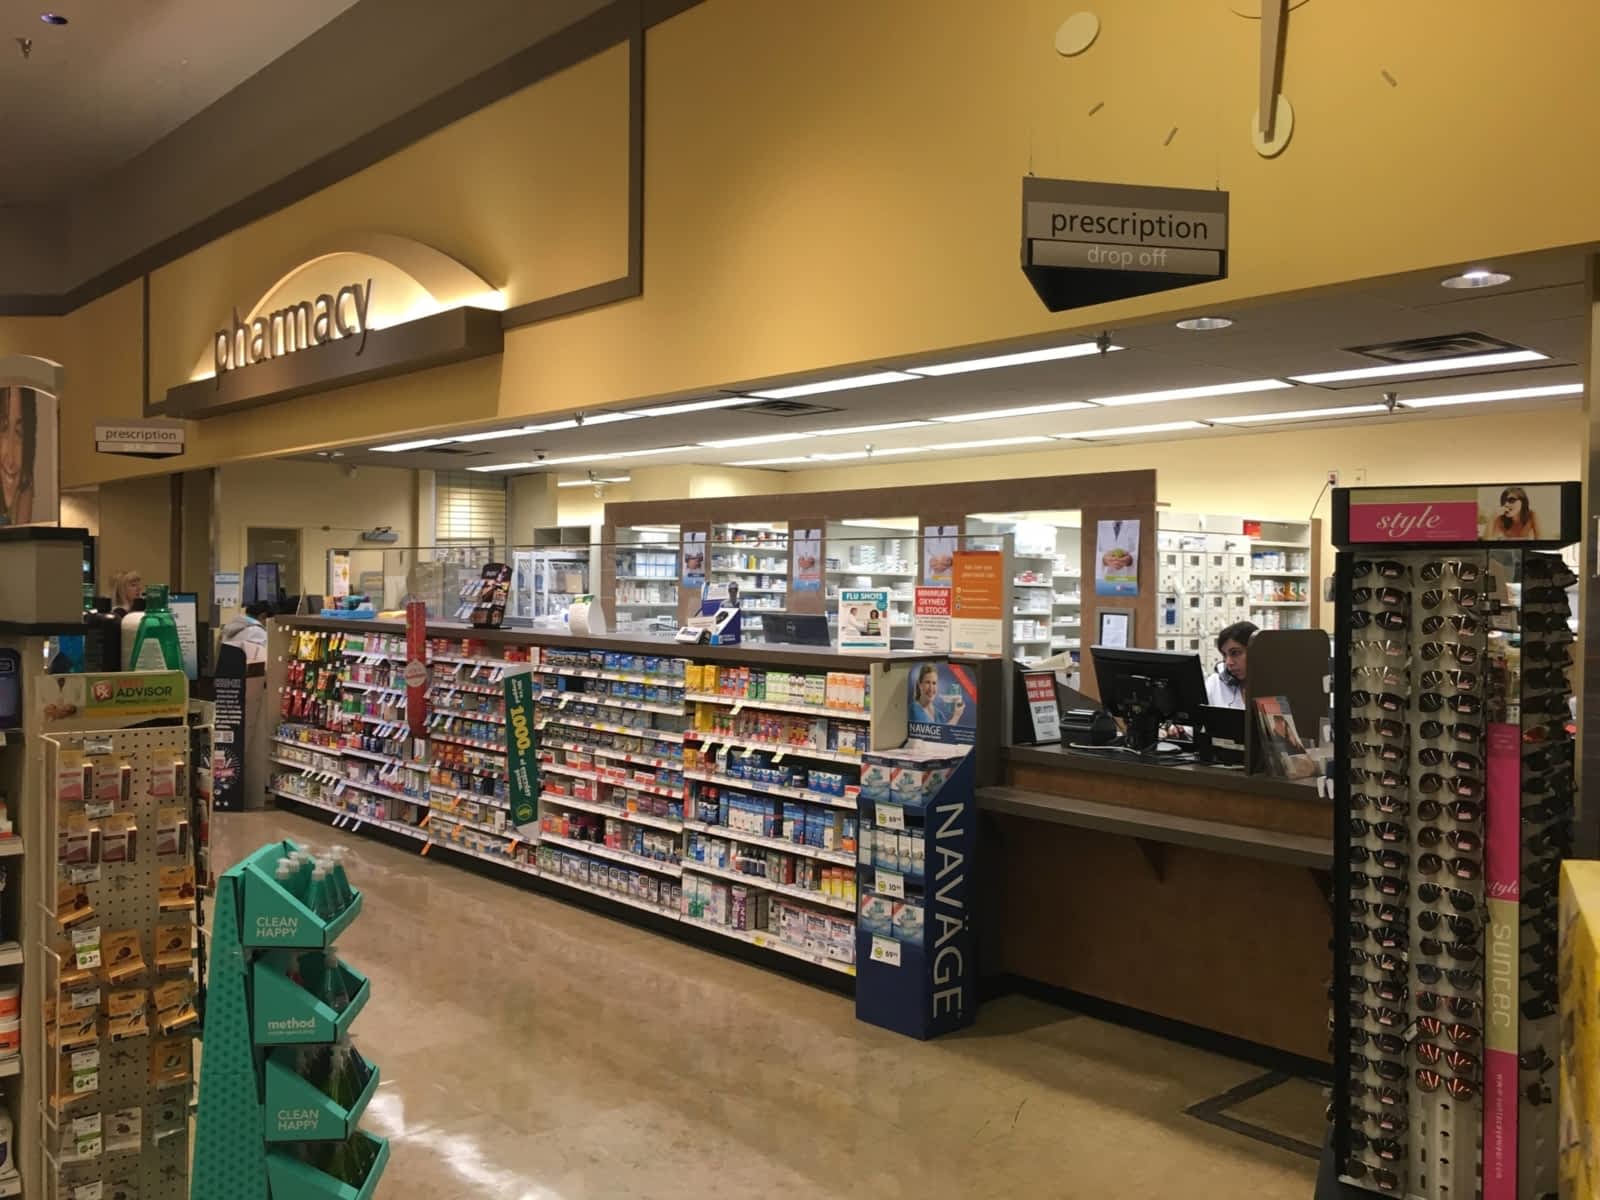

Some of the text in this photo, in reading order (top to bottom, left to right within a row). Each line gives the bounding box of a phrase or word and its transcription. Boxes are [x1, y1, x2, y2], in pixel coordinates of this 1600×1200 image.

[1051, 212, 1208, 242] prescription
[1088, 247, 1168, 269] drop off
[215, 278, 373, 391] pharmacy
[105, 430, 177, 441] prescription
[1376, 505, 1441, 538] style
[846, 592, 883, 601] FLU SHOTS
[917, 589, 949, 597] MINIMUM
[925, 607, 948, 615] STOCK
[115, 686, 172, 698] ADVISOR
[256, 916, 298, 928] CLEAN
[256, 927, 297, 938] HAPPY
[1491, 923, 1512, 1028] suntec
[267, 1017, 316, 1030] method
[277, 1109, 319, 1120] CLEAN
[278, 1120, 319, 1131] HAPPY
